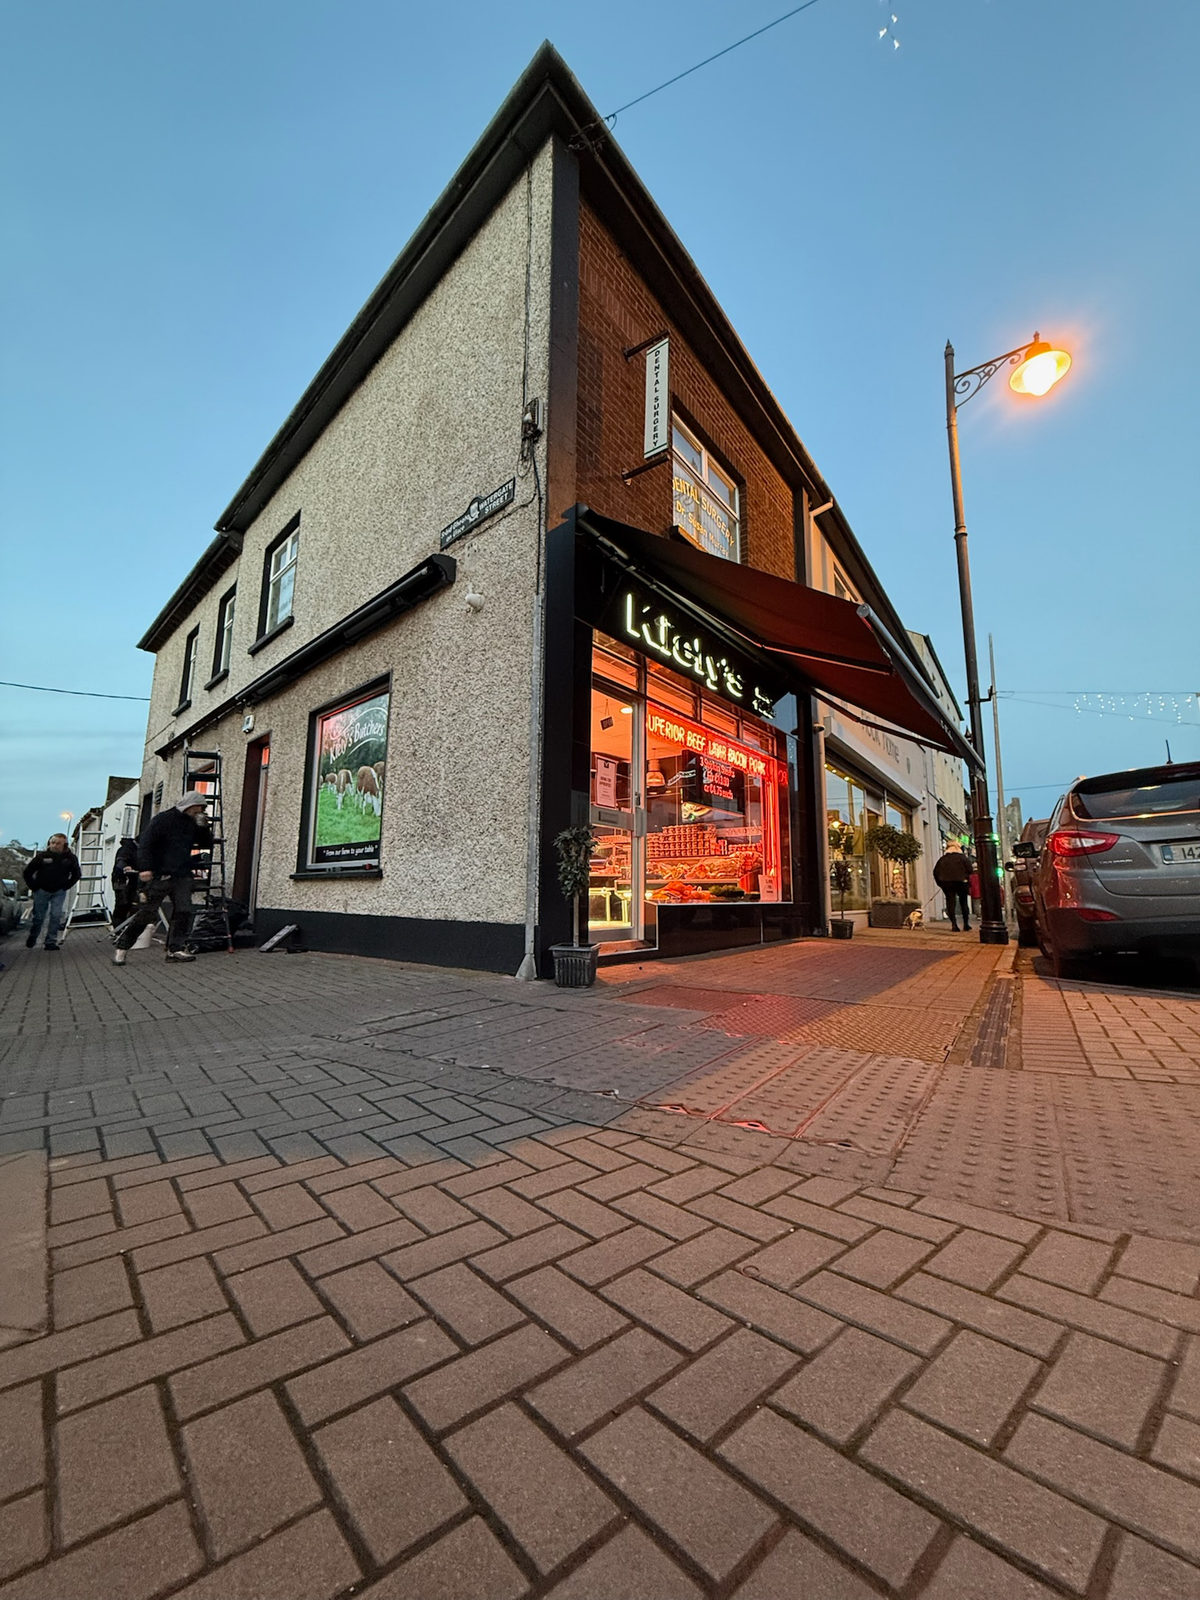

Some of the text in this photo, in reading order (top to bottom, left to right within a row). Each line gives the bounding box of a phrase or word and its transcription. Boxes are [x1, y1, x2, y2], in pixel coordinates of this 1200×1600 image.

[479, 480, 513, 510] WATERGATE
[484, 492, 508, 514] STREET
[701, 496, 735, 546] SURGERY
[647, 714, 685, 745] UPERIOR
[687, 731, 706, 750] BEEF
[728, 748, 747, 768] BACON
[749, 757, 766, 775] PORK
